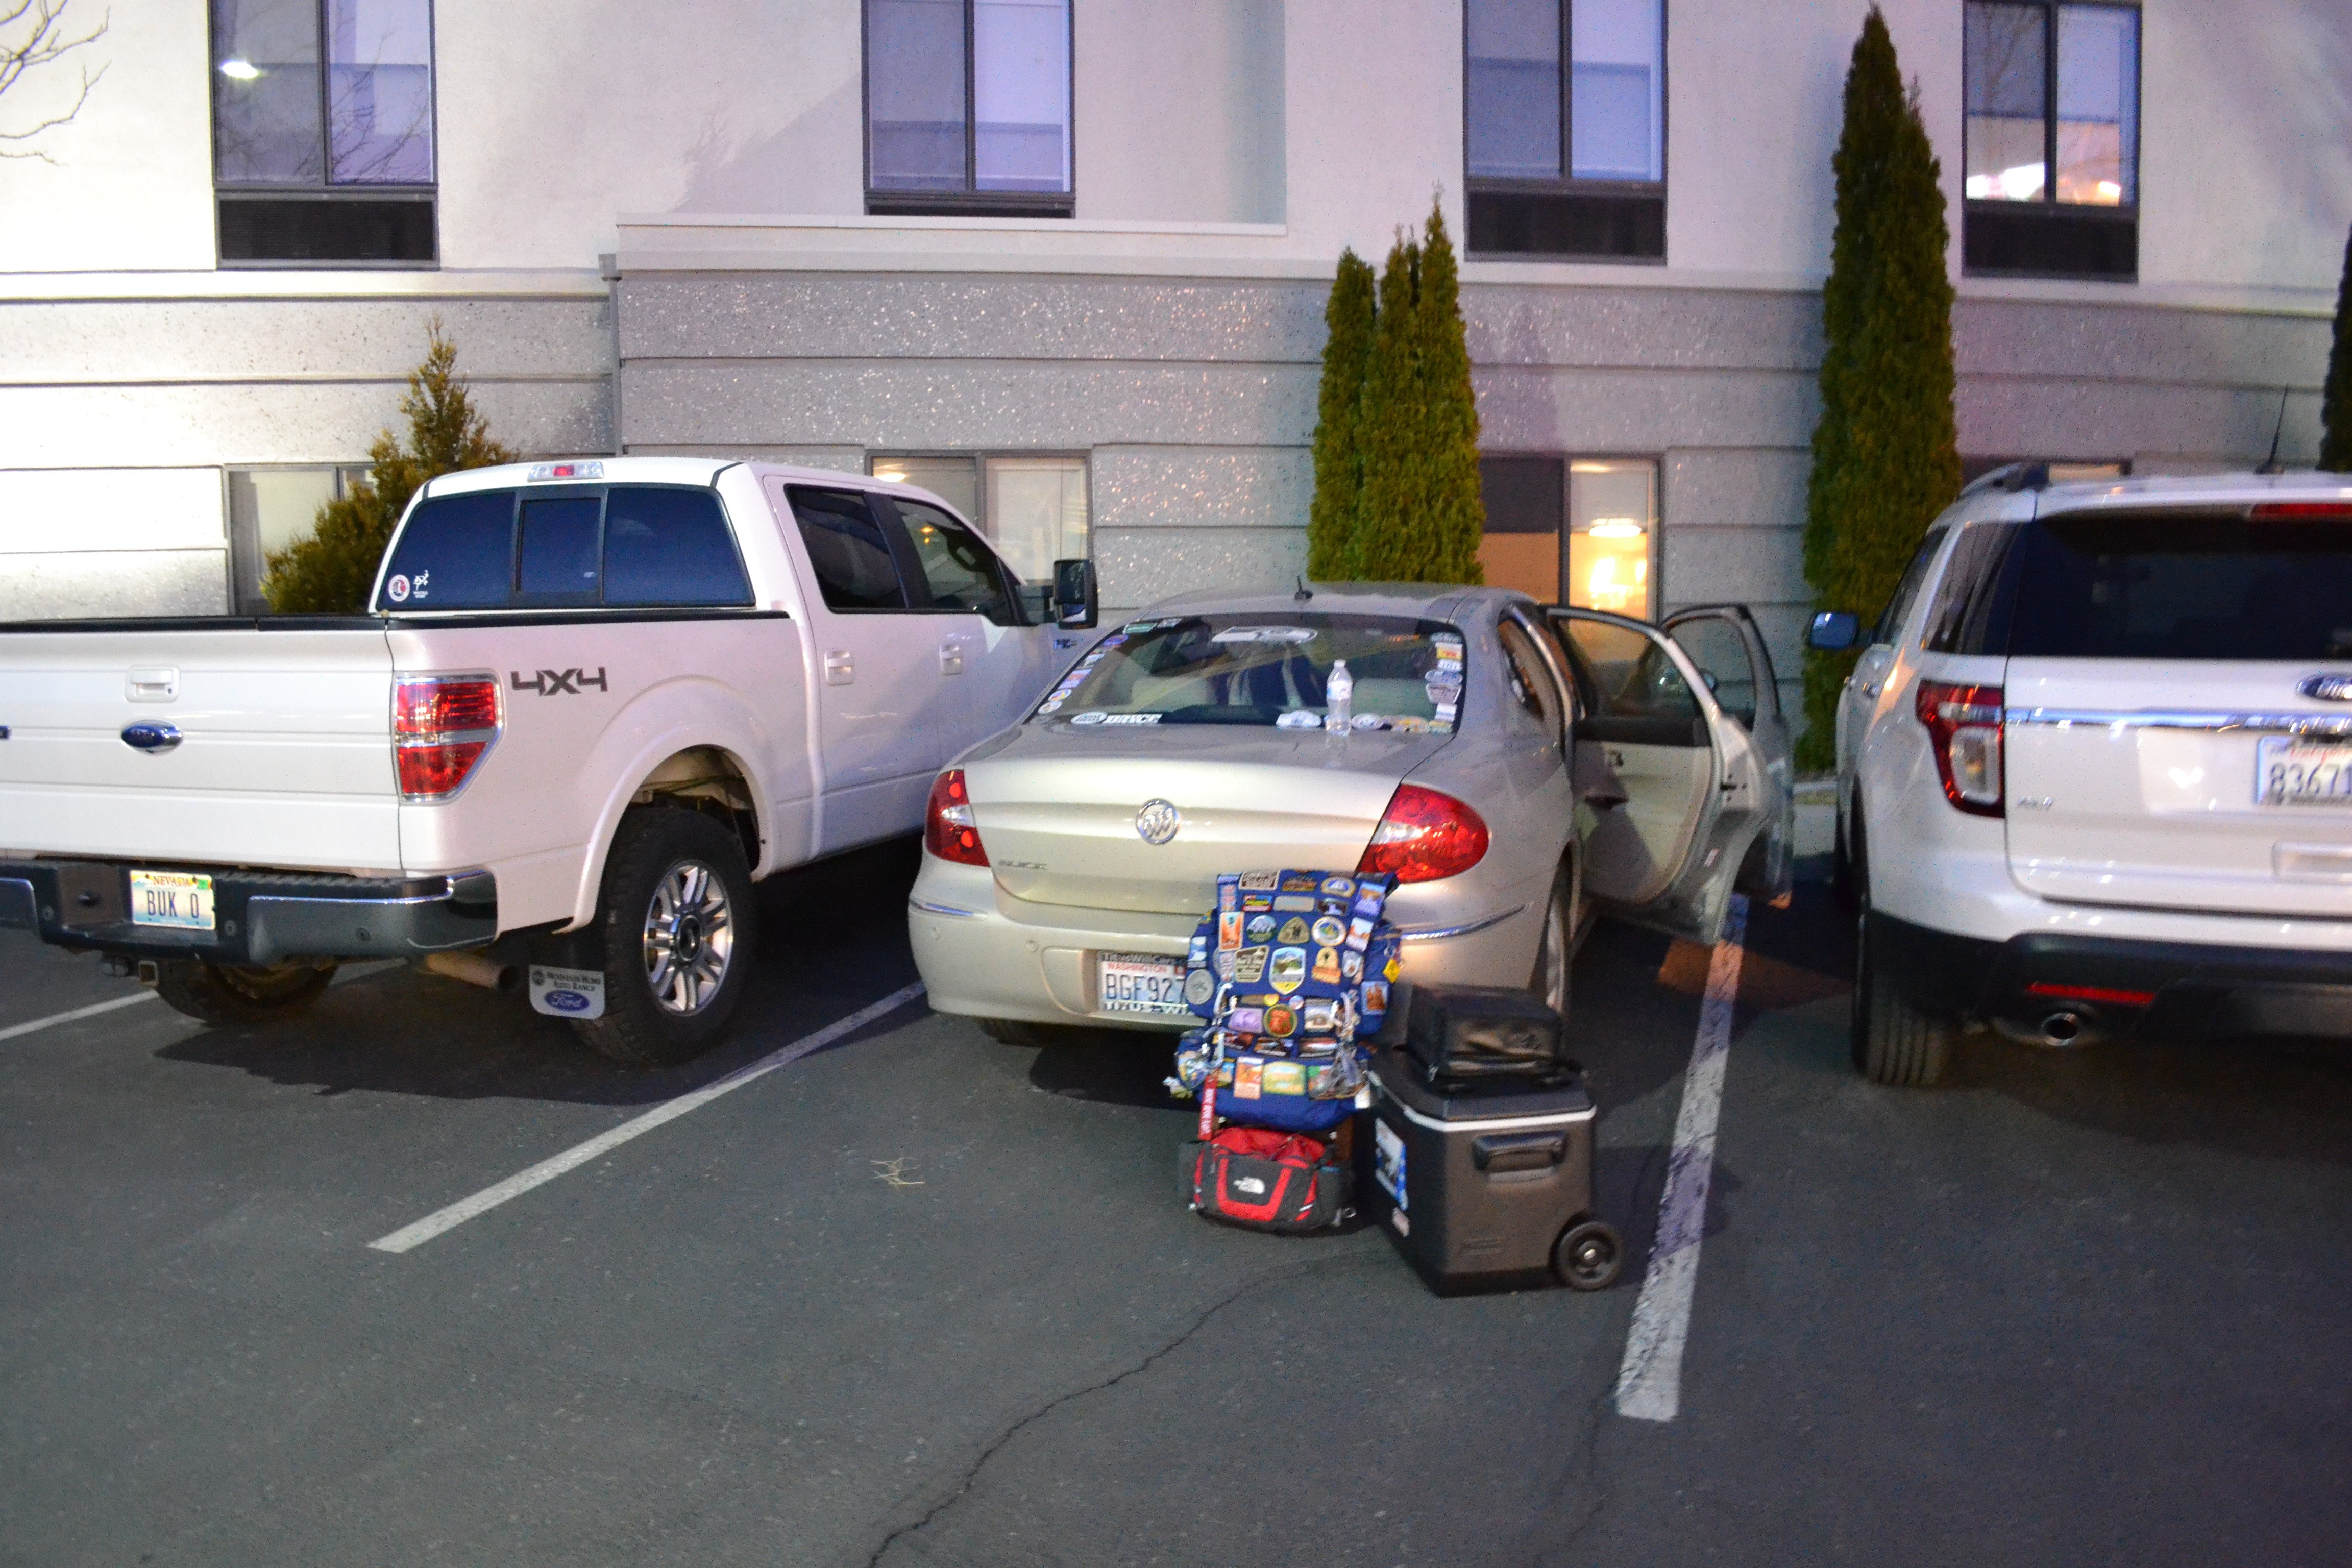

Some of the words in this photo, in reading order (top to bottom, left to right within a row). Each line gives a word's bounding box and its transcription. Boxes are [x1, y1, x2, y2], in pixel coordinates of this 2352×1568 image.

[511, 667, 608, 696] 4X4
[154, 876, 190, 886] NEVADA
[147, 890, 177, 917] BUK
[1108, 963, 1167, 972] WASHINGTON
